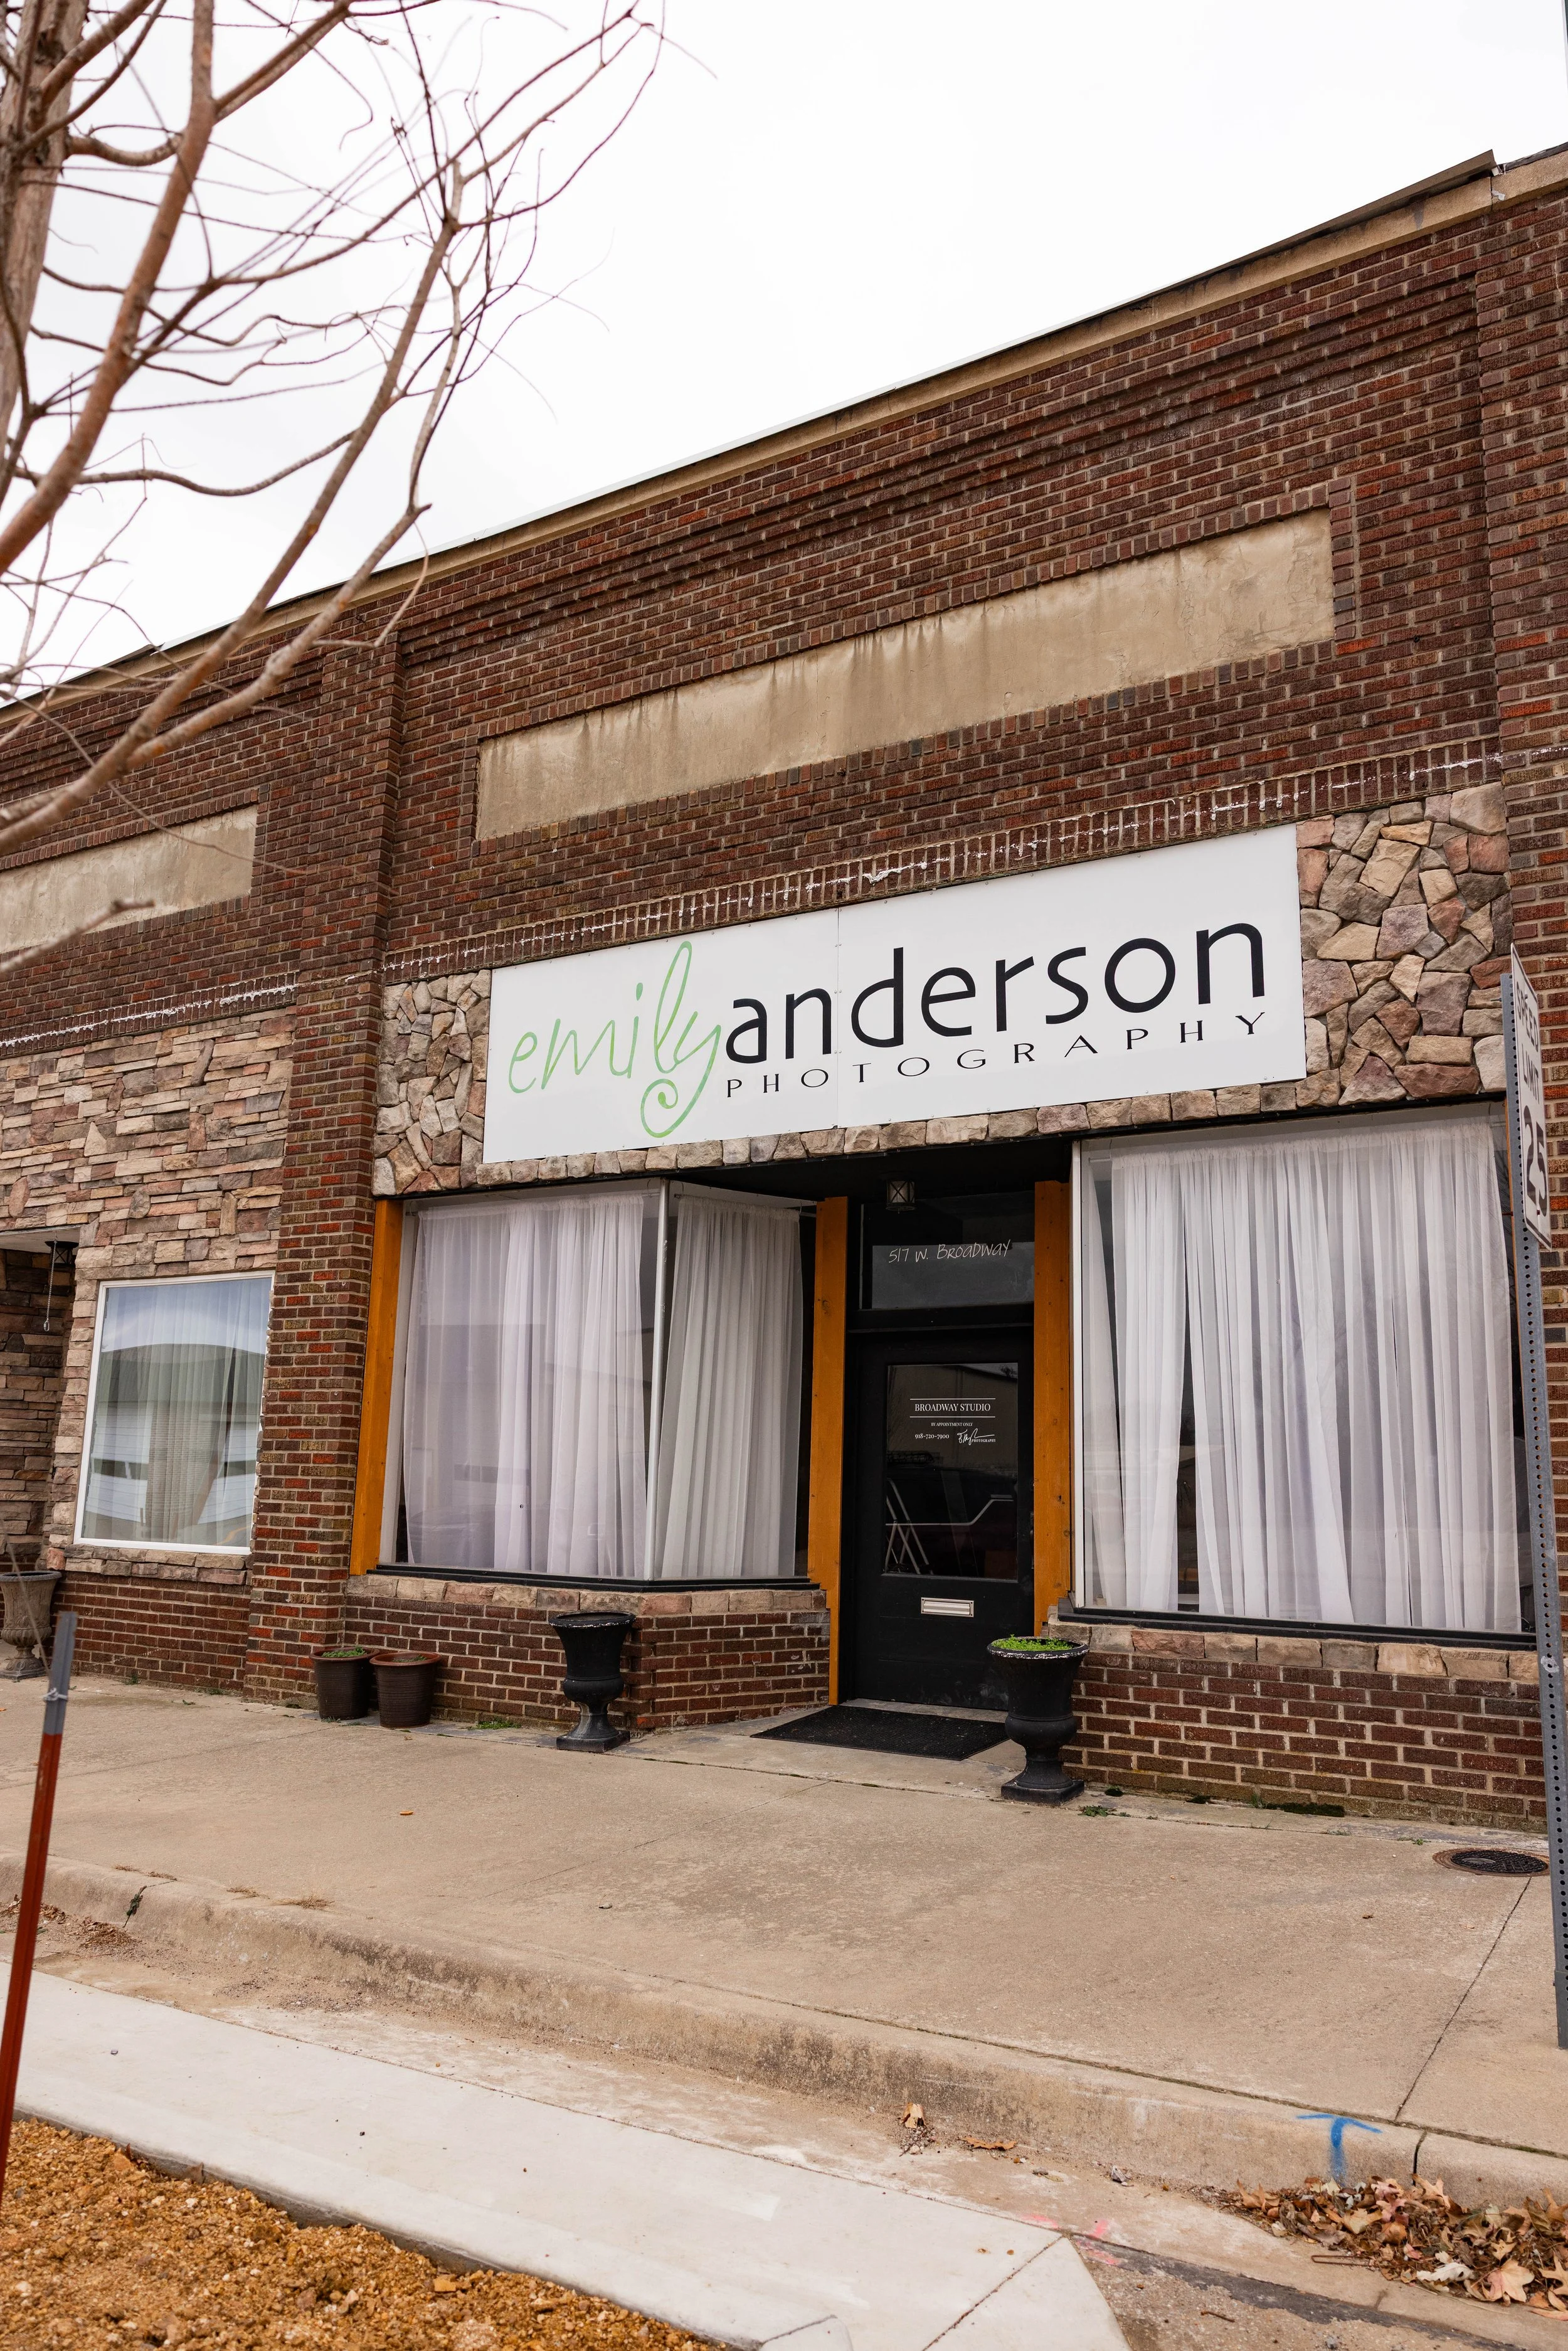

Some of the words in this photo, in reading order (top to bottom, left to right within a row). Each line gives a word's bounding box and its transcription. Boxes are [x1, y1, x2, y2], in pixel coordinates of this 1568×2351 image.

[508, 941, 722, 1138] emily
[725, 922, 1266, 1064] anderson
[1516, 981, 1539, 1053] SPEED
[726, 1011, 1266, 1099] PHOTOGRAPHY
[1521, 1043, 1540, 1105] LIMIT
[1523, 1105, 1548, 1218] 25
[888, 1248, 909, 1263] 517
[914, 1403, 958, 1411] BROADWAY
[960, 1403, 991, 1411] STUDIO
